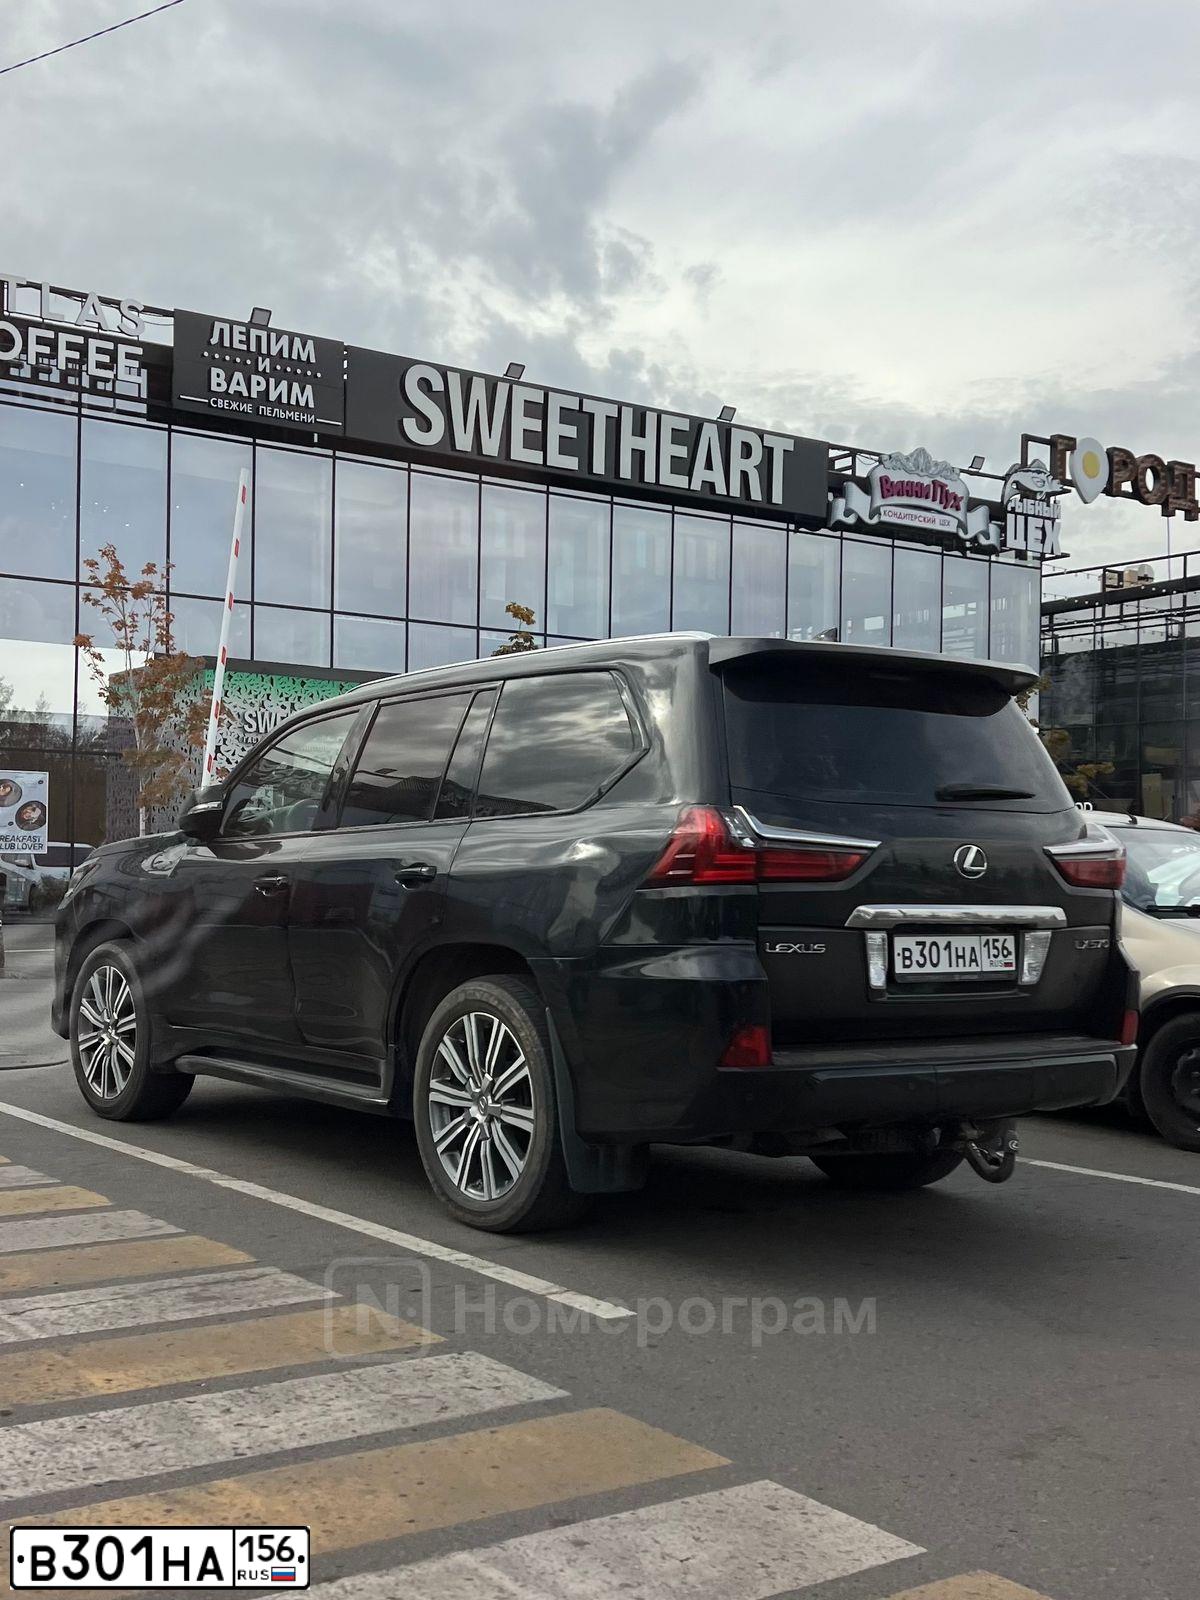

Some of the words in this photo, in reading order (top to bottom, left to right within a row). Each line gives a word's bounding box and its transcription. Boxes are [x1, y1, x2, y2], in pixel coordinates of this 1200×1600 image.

[210, 320, 317, 364] ЛЕПИМ
[258, 356, 270, 373] И
[210, 366, 315, 409] ВАРИМ
[210, 397, 253, 414] СВЕЖИЕ
[259, 405, 315, 424] ПЕЛЬМЕНИ
[402, 364, 795, 505] SWEETHEART
[883, 510, 936, 525] КОНДИТЕРСКИЙ
[1006, 513, 1062, 556] ЦЕХ
[17, 843, 44, 851] LOVER
[765, 942, 827, 954] LEXUS
[902, 940, 979, 969] В301НА
[983, 938, 1009, 960] 156
